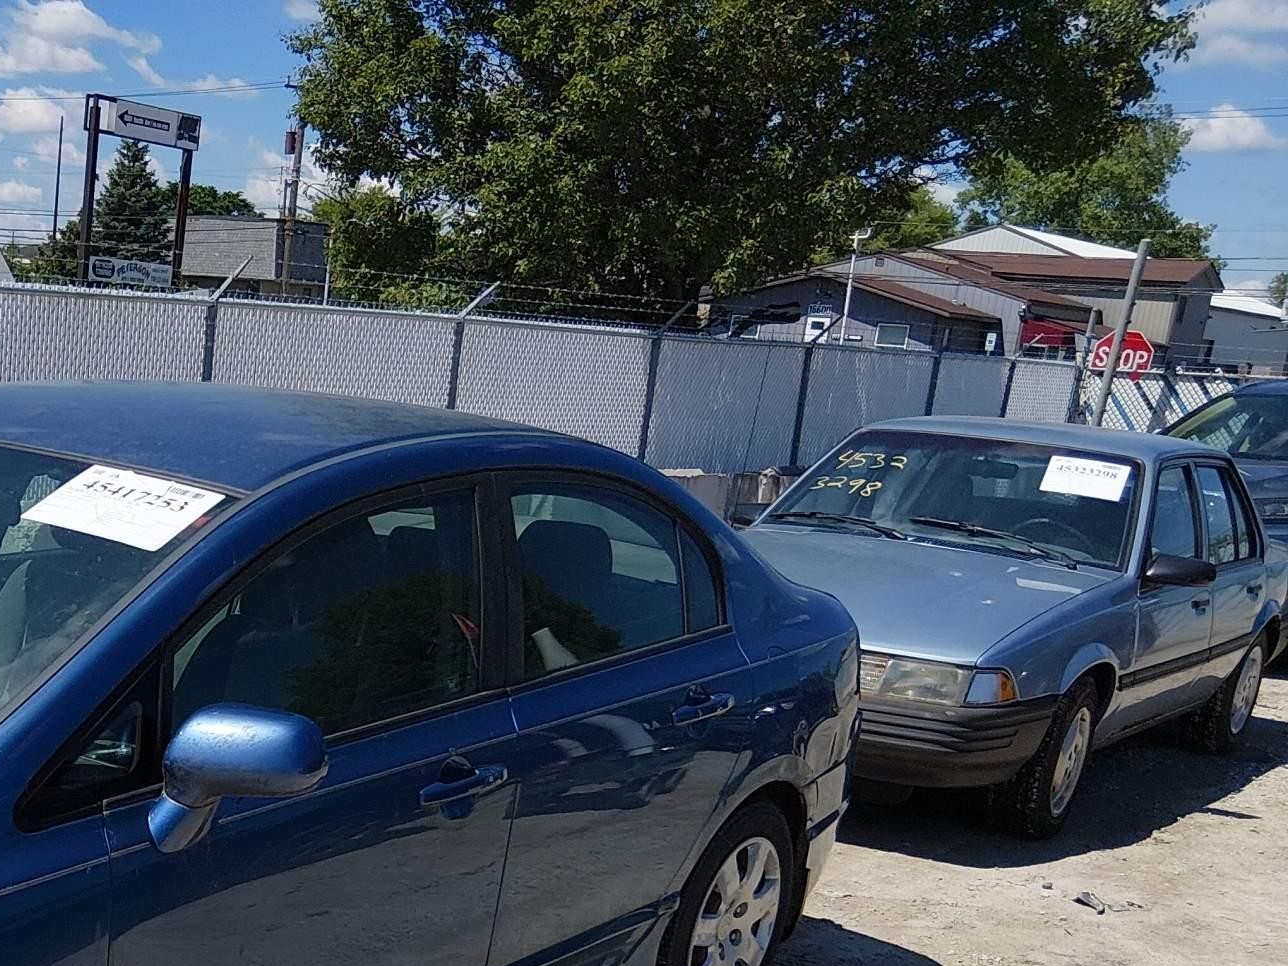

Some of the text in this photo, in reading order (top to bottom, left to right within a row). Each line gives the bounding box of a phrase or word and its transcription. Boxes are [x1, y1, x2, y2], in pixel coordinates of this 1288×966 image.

[1095, 346, 1148, 370] SOP
[836, 450, 908, 471] 4532
[1056, 464, 1119, 480] 45323298
[82, 479, 190, 513] 45417253
[809, 475, 882, 497] 3298
